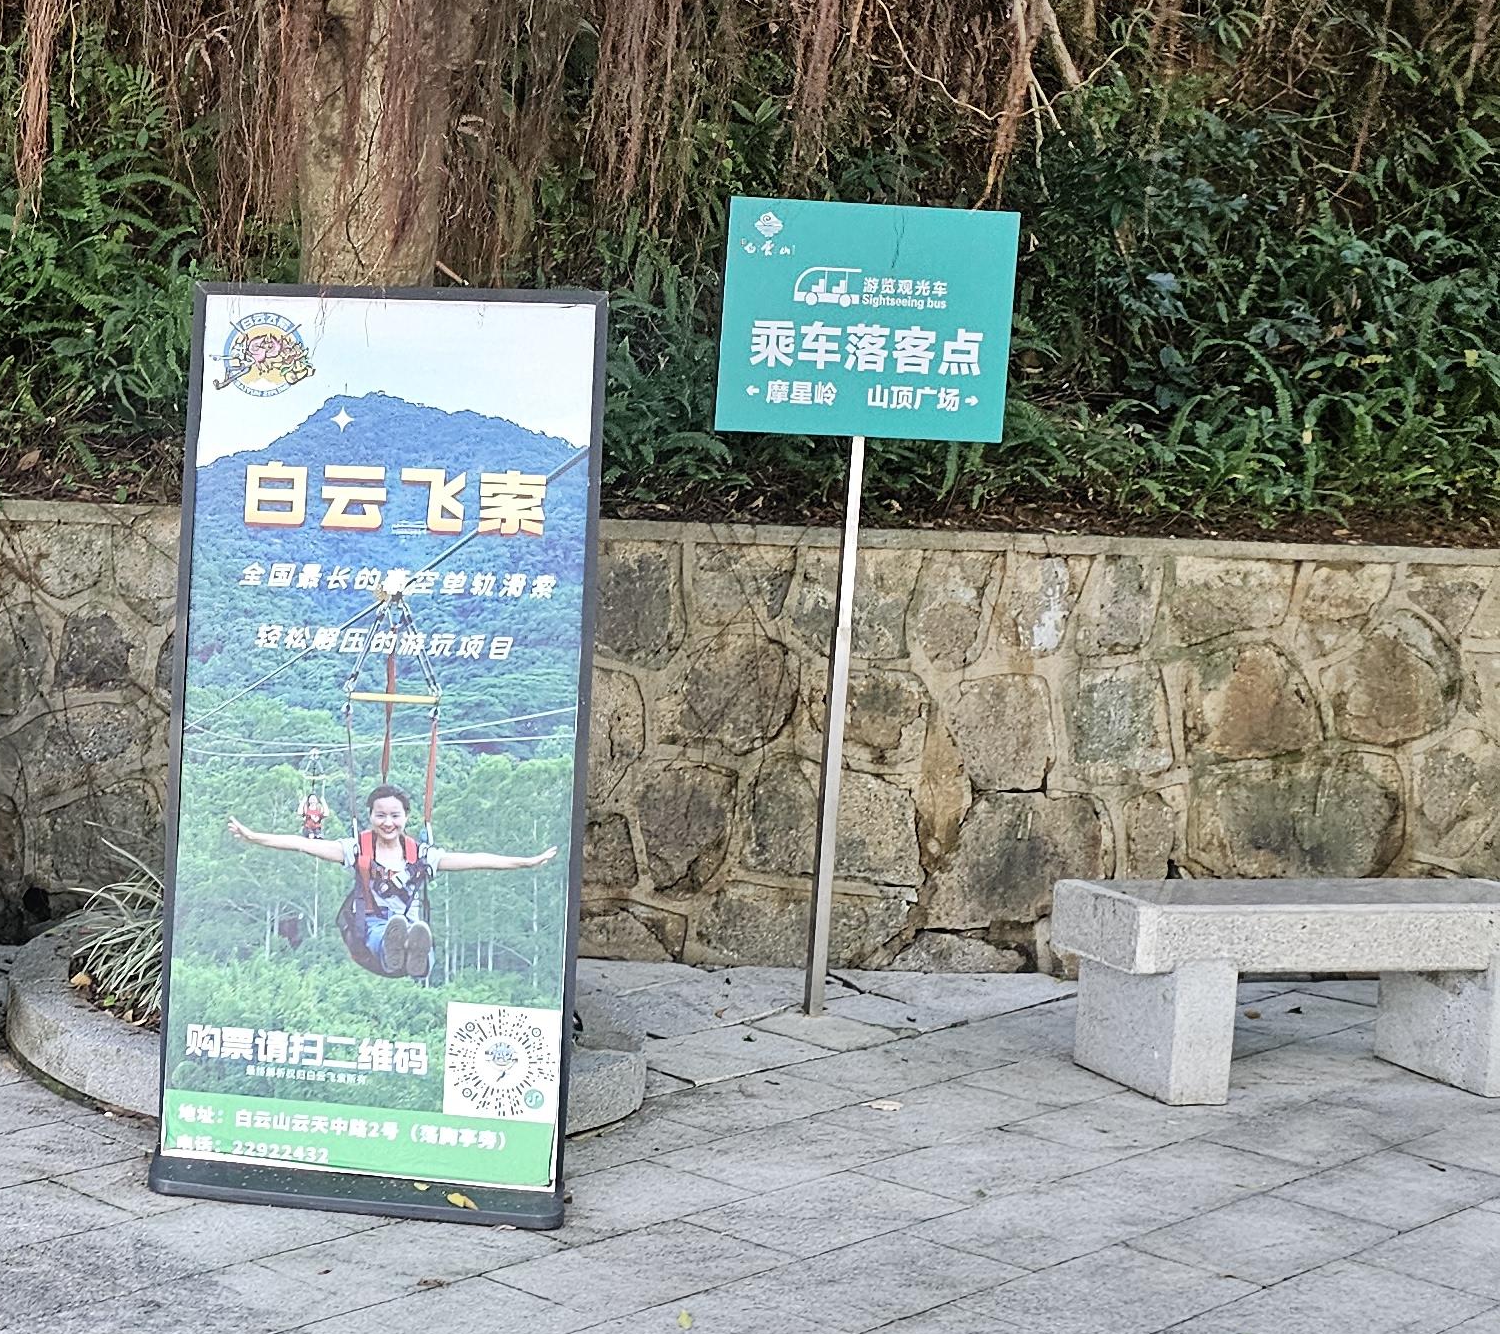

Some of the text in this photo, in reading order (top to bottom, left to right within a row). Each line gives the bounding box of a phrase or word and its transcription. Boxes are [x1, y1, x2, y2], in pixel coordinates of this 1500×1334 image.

[862, 294, 948, 310] Sightseeing bus
[863, 277, 948, 297] 游览观光车
[749, 319, 983, 376] 乘车落客点
[766, 380, 960, 412] 摩星岭 山顶广场
[244, 461, 547, 536] 白云飞索
[254, 623, 515, 661] 轻松解压的游玩项目
[185, 1023, 428, 1076] 购票请扫二维码
